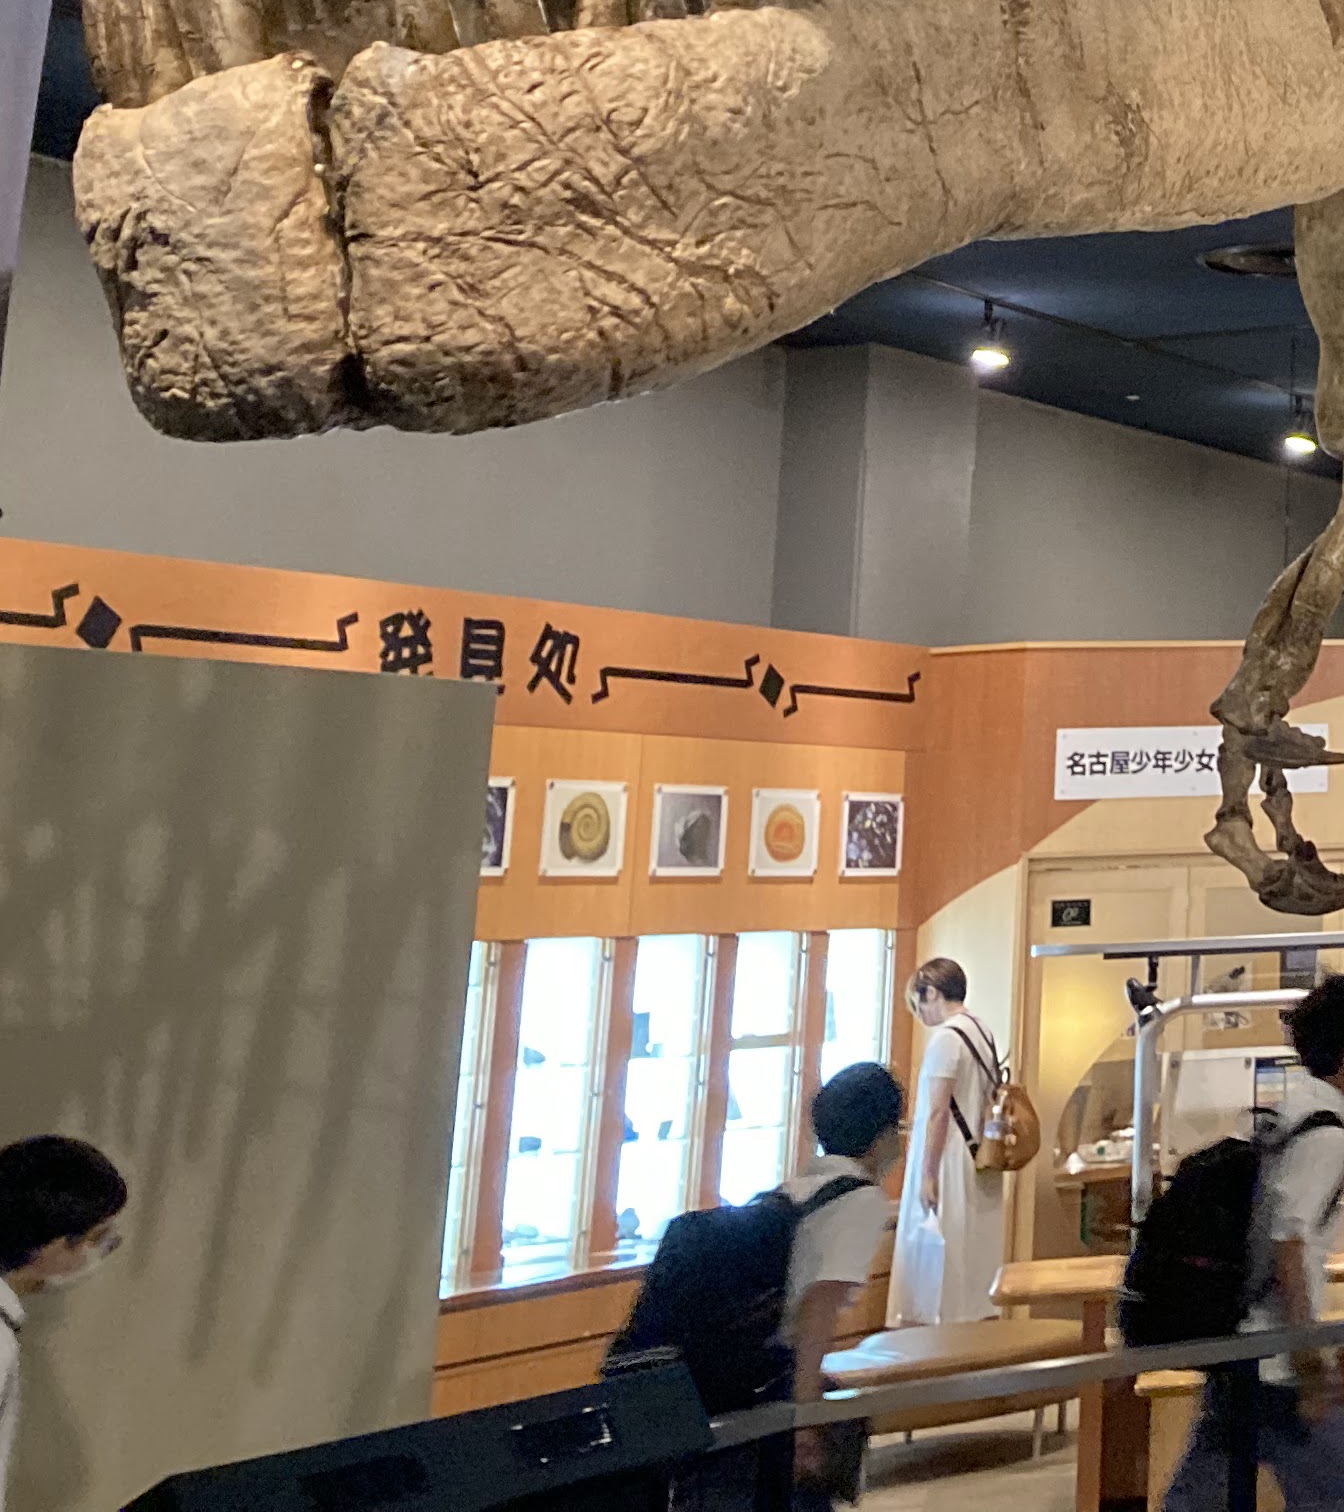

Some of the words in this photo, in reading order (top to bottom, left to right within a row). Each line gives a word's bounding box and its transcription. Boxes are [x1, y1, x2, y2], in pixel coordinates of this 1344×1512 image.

[1066, 749, 1219, 776] 名古屋少年少女
